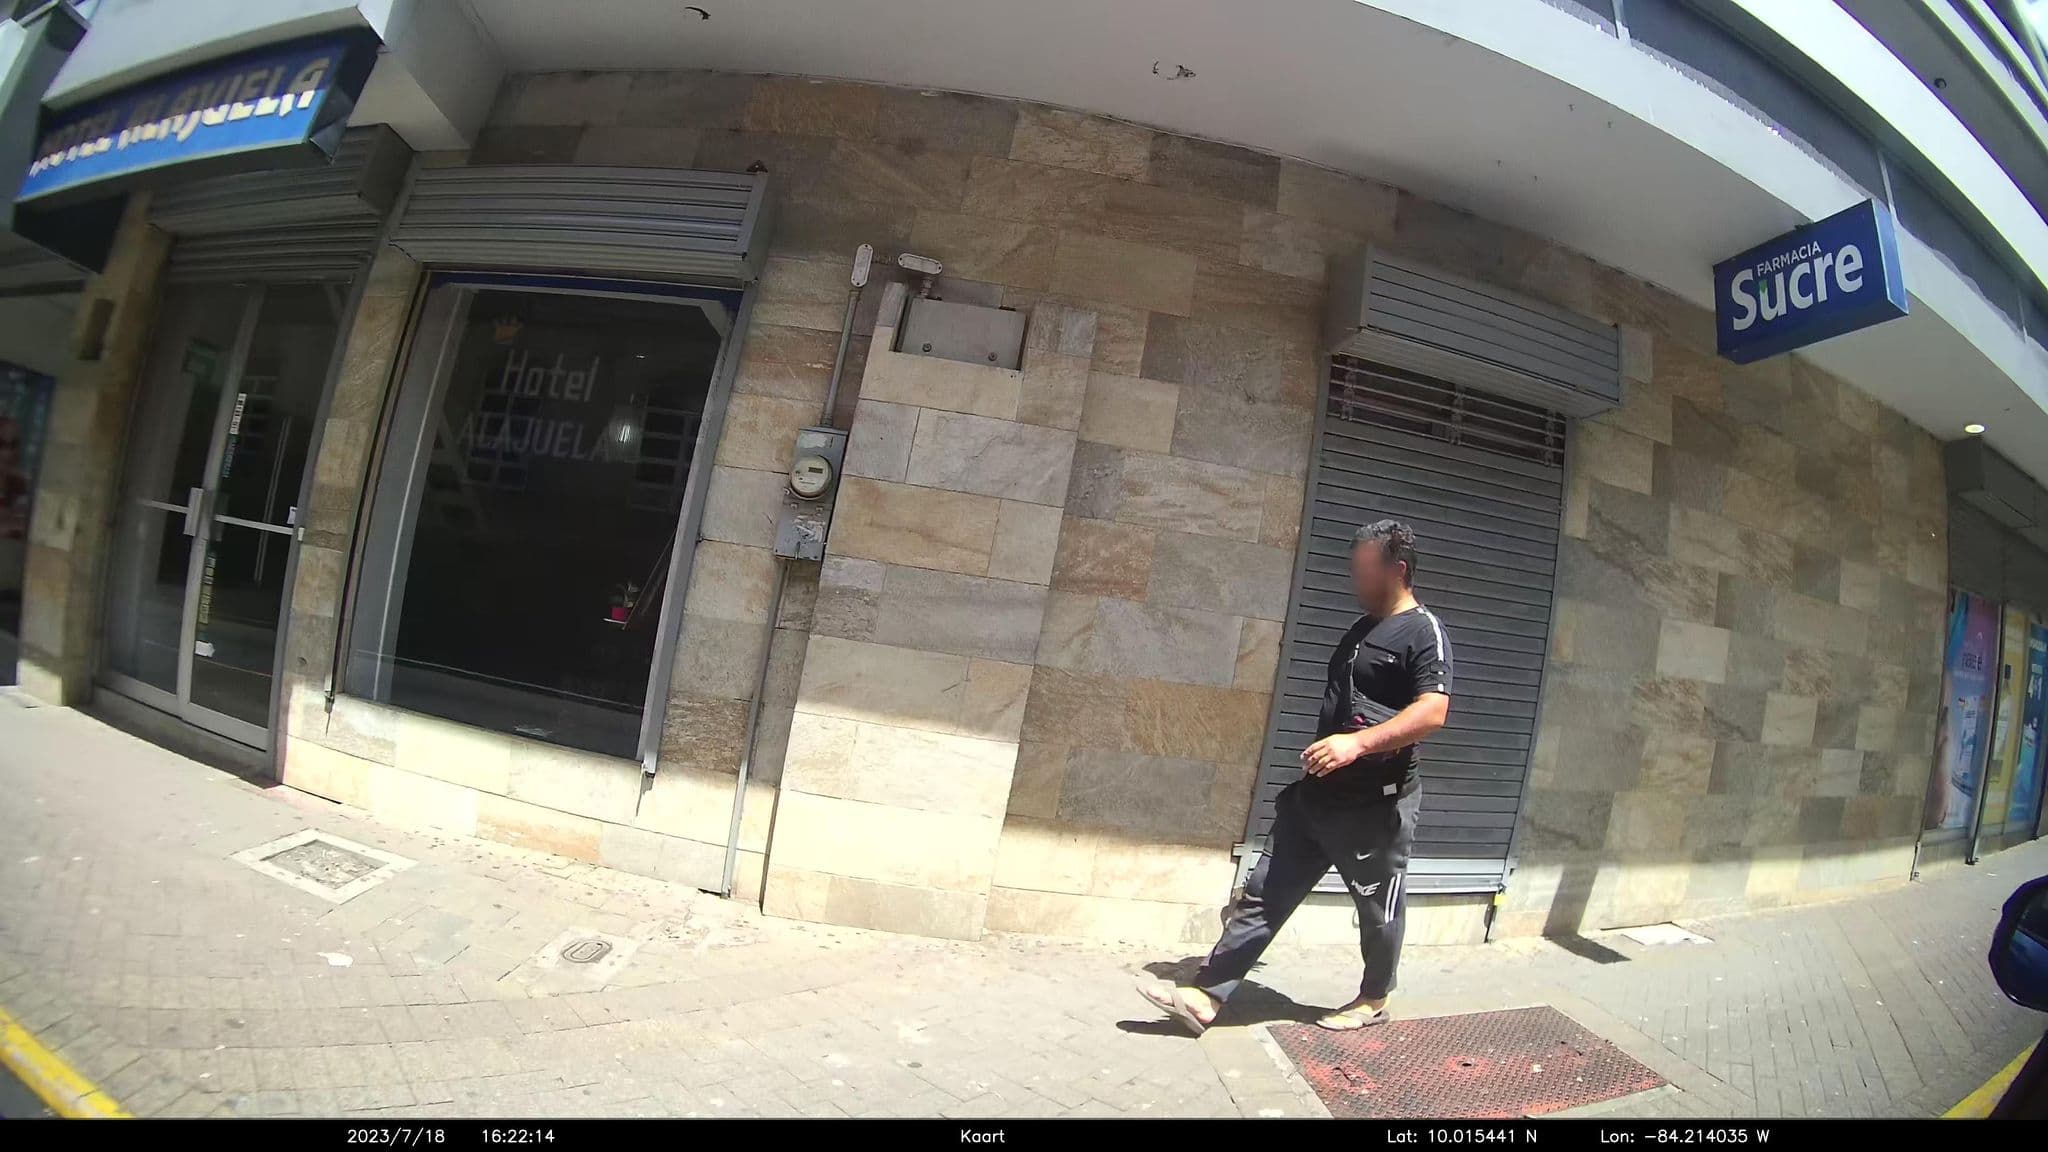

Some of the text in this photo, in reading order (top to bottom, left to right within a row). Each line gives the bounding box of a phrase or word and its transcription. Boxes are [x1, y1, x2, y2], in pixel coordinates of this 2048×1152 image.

[28, 57, 330, 178] HOTEL ALAJUELA
[1730, 244, 1864, 331] Sucre
[1756, 240, 1822, 277] FARMACIA
[500, 349, 599, 402] Hotel
